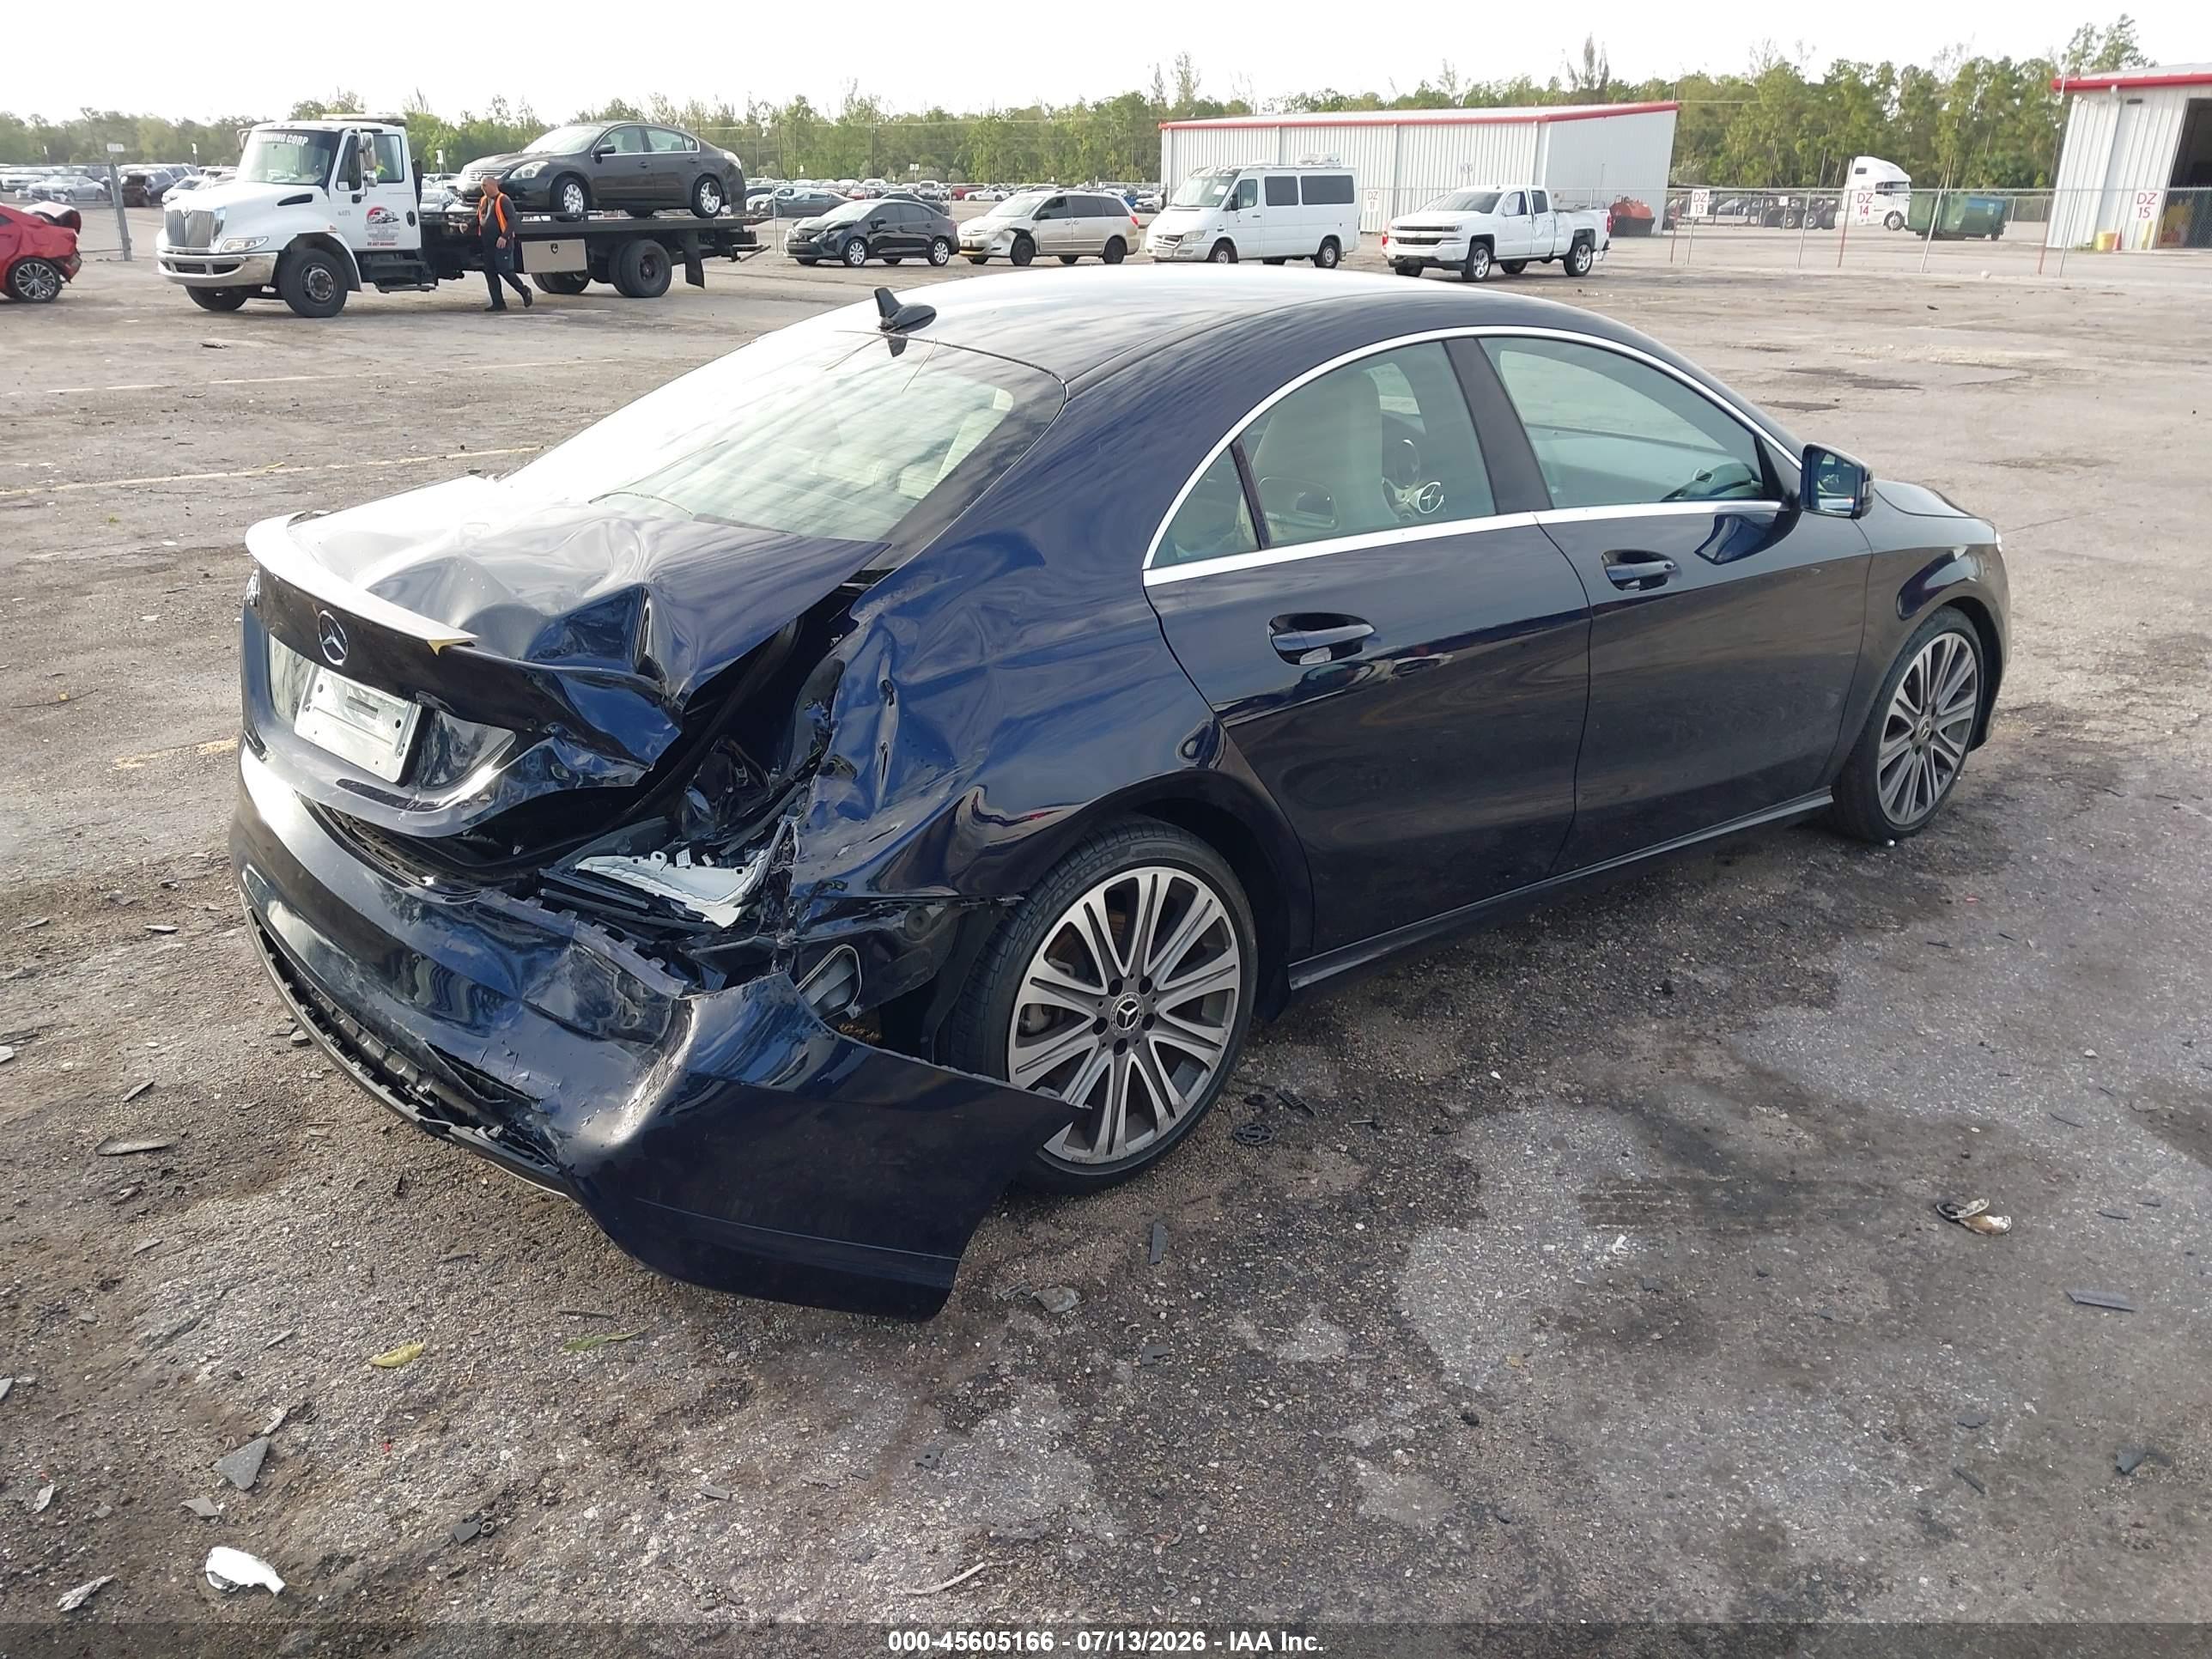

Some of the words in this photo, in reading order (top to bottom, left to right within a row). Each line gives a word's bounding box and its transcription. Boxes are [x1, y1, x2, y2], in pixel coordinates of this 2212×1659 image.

[286, 134, 309, 147] CORP
[1367, 191, 1378, 200] DZ
[1693, 191, 1709, 203] DZ
[1856, 192, 1875, 204] DZ
[2136, 191, 2158, 205] DZ
[1695, 204, 1705, 214] 13
[1859, 205, 1869, 216] 14
[2137, 206, 2151, 219] 15
